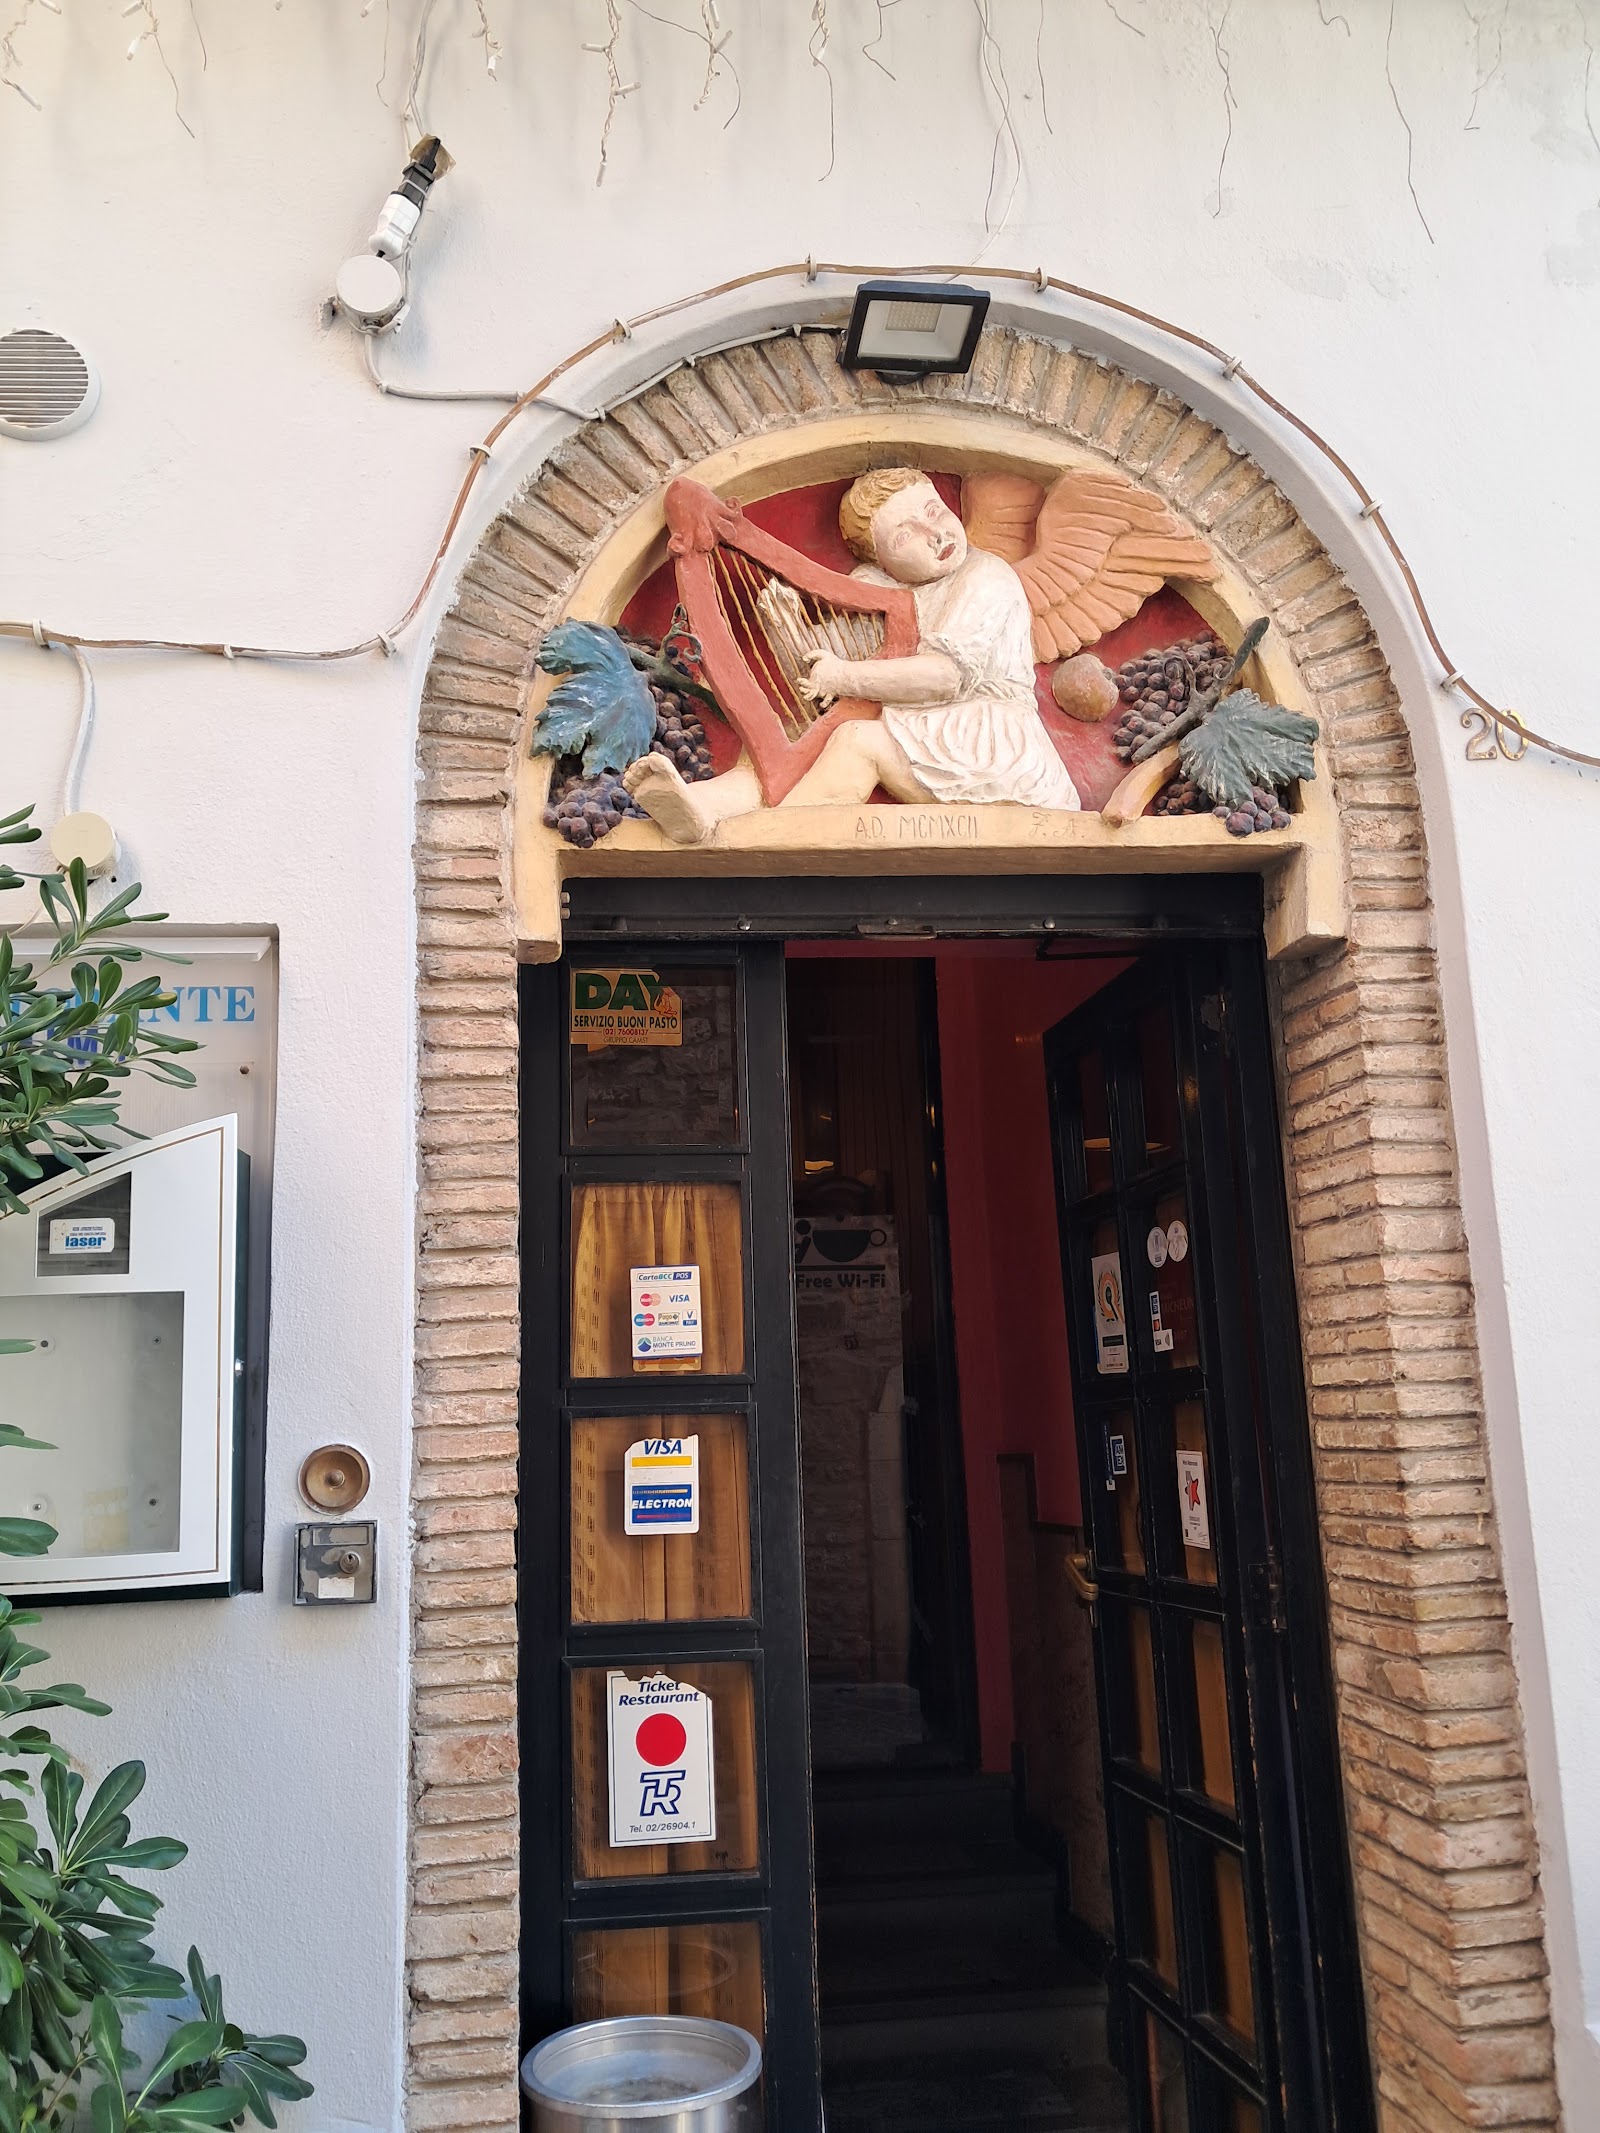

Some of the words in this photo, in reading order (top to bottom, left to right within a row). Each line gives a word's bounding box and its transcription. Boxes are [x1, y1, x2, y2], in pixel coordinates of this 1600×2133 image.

[1460, 707, 1529, 761] 20
[899, 814, 977, 839] MCMXCII
[574, 1015, 615, 1028] SERVIZIO
[617, 1016, 647, 1029] BUONI
[649, 1016, 678, 1029] PASTO
[602, 1029, 617, 1037] (02)
[65, 1236, 107, 1247] laser
[797, 1273, 832, 1288] Free
[838, 1273, 886, 1288] Wi-Fi
[669, 1294, 690, 1303] VISA
[686, 1310, 694, 1319] V
[644, 1439, 682, 1455] VISA
[631, 1498, 693, 1509] ELECTRON
[638, 1680, 681, 1693] Ticket
[618, 1691, 700, 1706] Restaurant
[629, 1825, 643, 1834] Tel.
[645, 1821, 696, 1832] 02/26904.1
